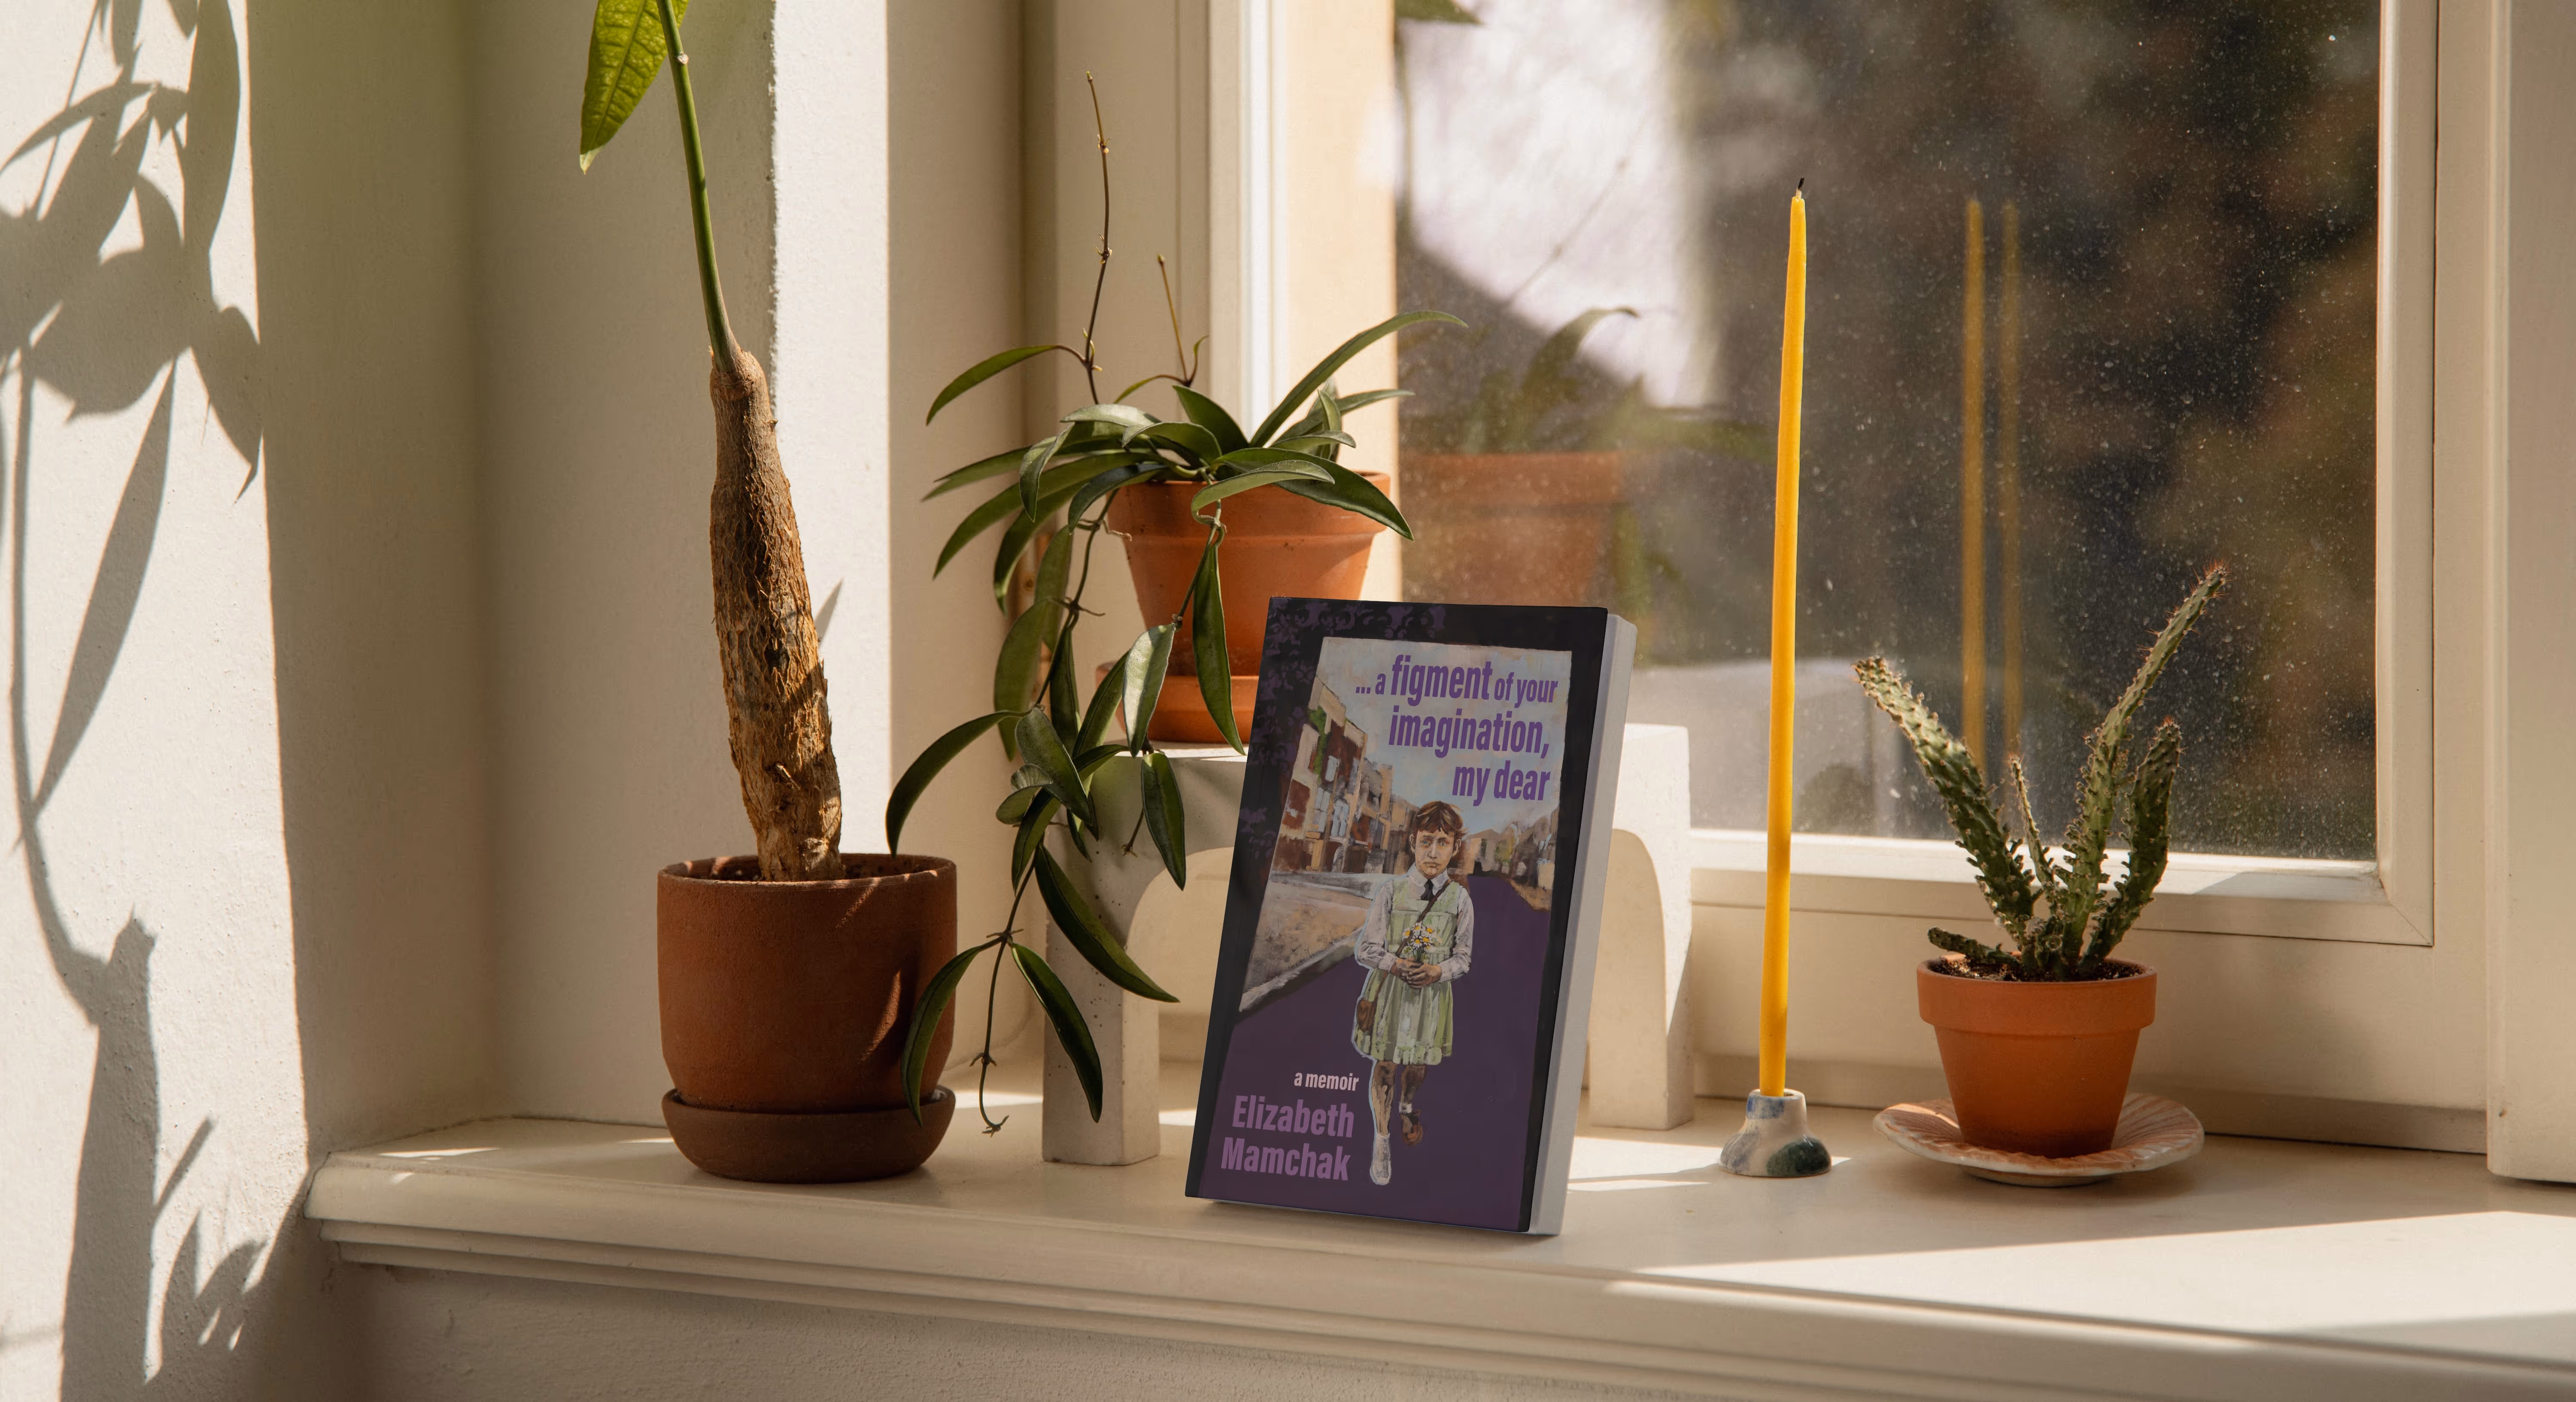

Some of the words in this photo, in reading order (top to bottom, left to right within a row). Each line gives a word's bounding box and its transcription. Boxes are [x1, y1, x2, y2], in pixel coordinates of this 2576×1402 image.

[1375, 673, 1387, 695] a
[1390, 654, 1493, 707] figment
[1494, 672, 1515, 701] of
[1514, 679, 1558, 708] your
[1388, 705, 1549, 759] imagination,
[1452, 765, 1491, 807] my
[1493, 760, 1551, 801] dear
[1294, 1072, 1302, 1087] a
[1305, 1072, 1359, 1091] memoir
[1232, 1095, 1355, 1138] Elizabeth
[1220, 1137, 1353, 1181] Mamchak
